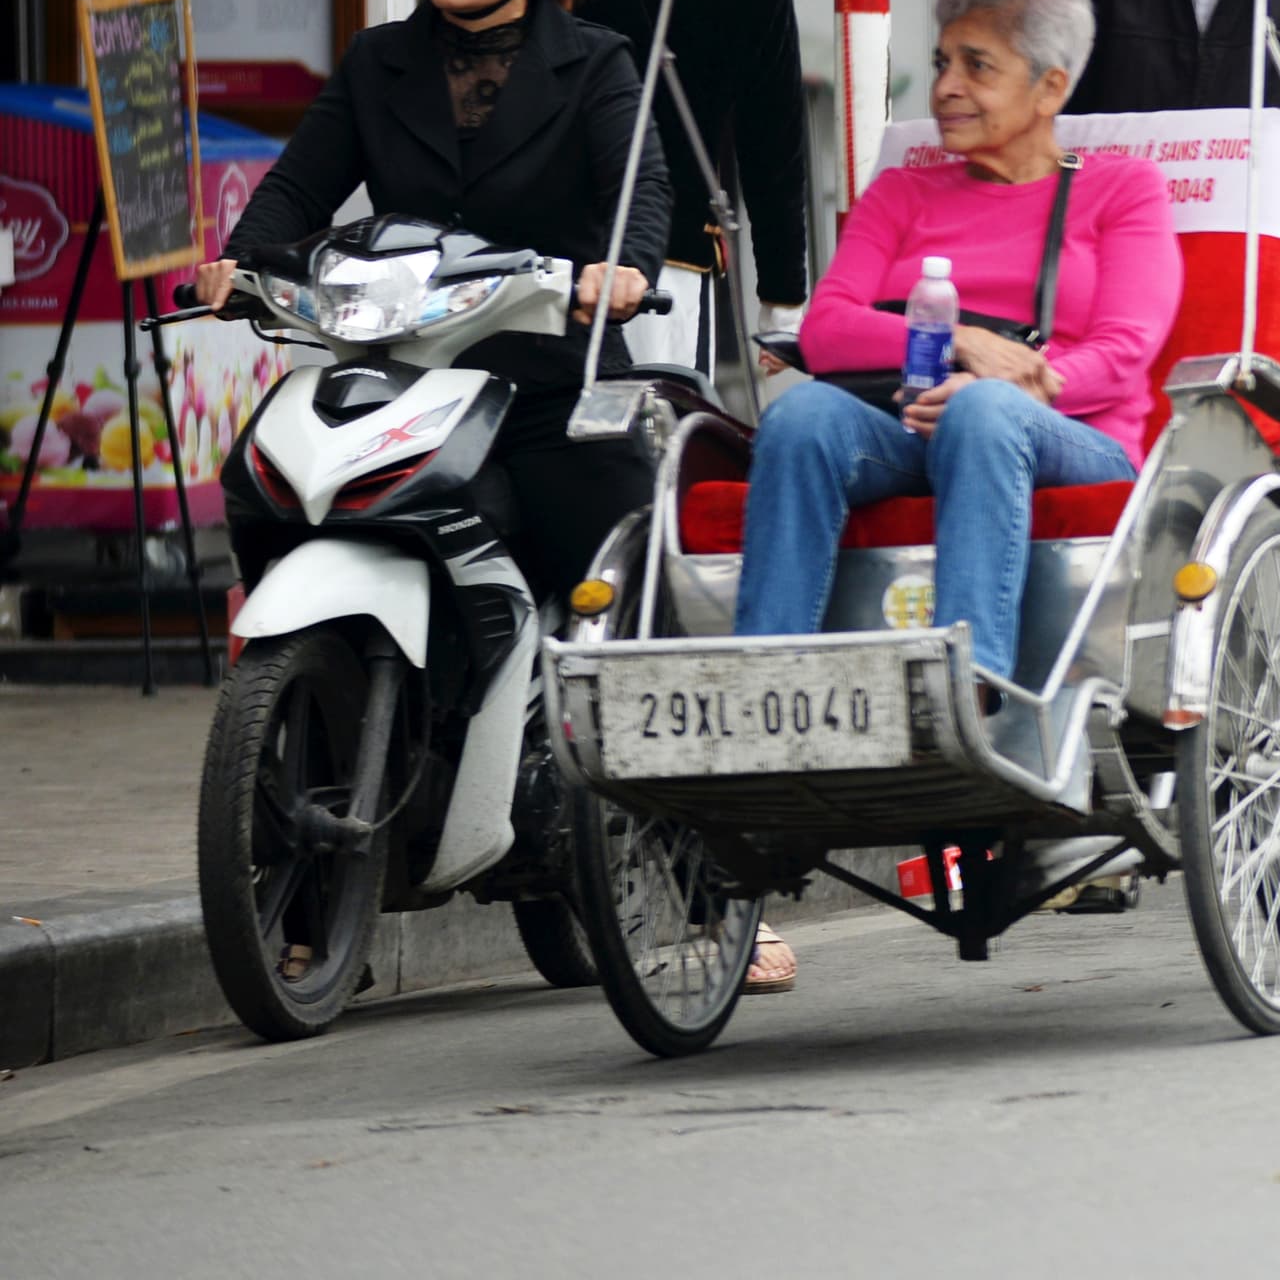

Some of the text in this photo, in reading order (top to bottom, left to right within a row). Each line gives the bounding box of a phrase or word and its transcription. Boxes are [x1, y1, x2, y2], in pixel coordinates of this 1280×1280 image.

[1157, 139, 1202, 163] SANS
[1205, 137, 1251, 161] SOUC
[437, 515, 483, 535] HONDA
